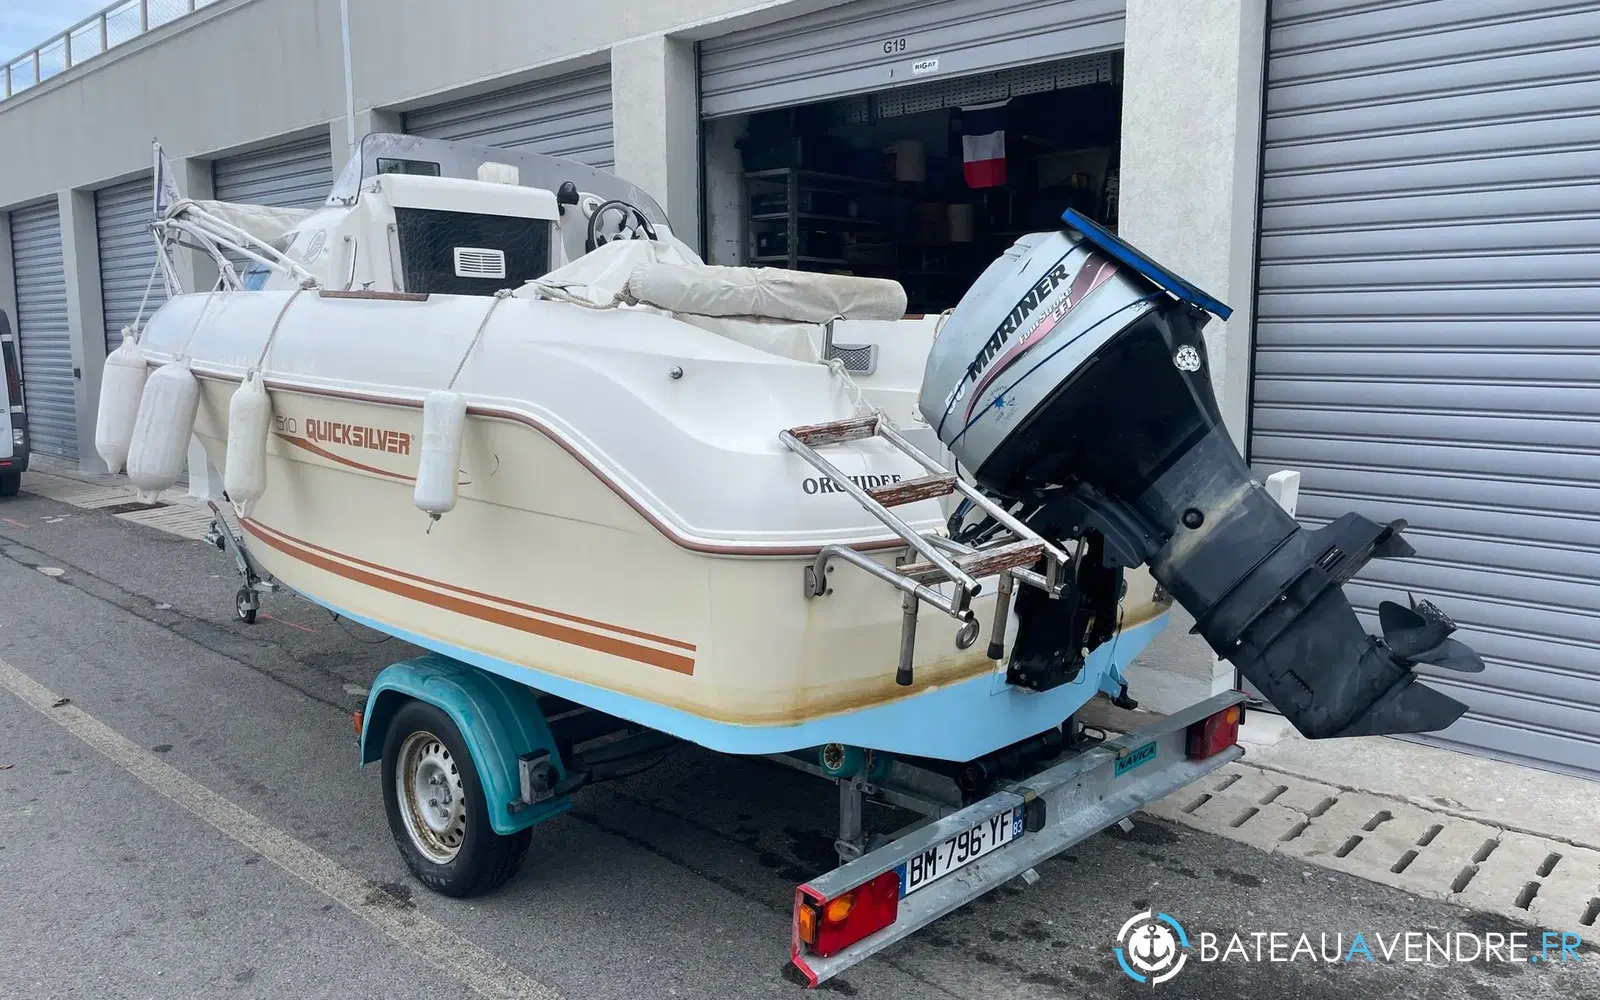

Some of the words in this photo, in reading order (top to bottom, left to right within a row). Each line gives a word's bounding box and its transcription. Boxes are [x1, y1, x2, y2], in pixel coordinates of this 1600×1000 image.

[883, 38, 906, 54] G19
[966, 263, 1070, 383] MARINER
[1018, 287, 1073, 345] FourStroke
[1052, 297, 1073, 323] EFI
[276, 415, 297, 434] 510
[306, 418, 411, 456] QUICKSILVER
[1117, 745, 1154, 771] NAVICA
[909, 808, 1012, 888] BM-796-YF
[1012, 819, 1023, 836] 83
